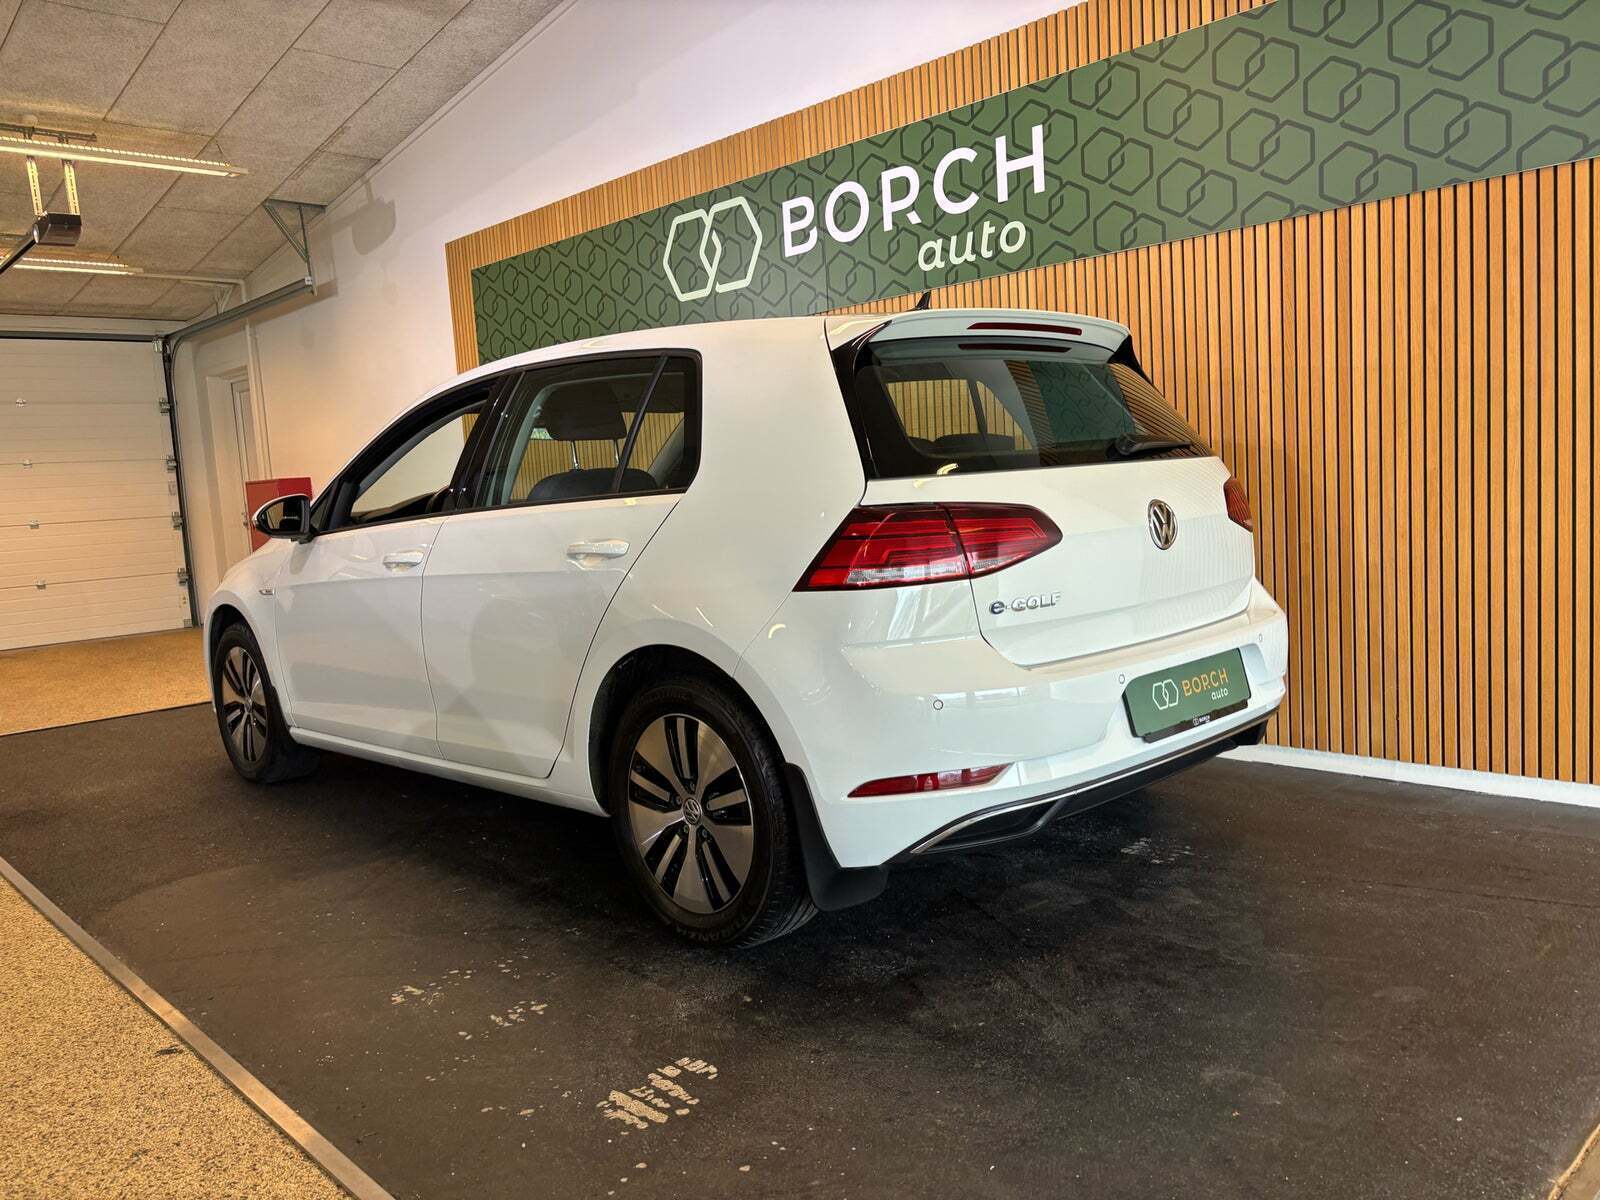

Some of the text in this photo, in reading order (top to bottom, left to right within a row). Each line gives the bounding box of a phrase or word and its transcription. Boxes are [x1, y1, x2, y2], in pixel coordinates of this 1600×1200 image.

[781, 124, 1046, 258] BORCH
[917, 220, 1027, 272] auto
[1181, 668, 1229, 697] BORCH
[1211, 687, 1229, 701] auto
